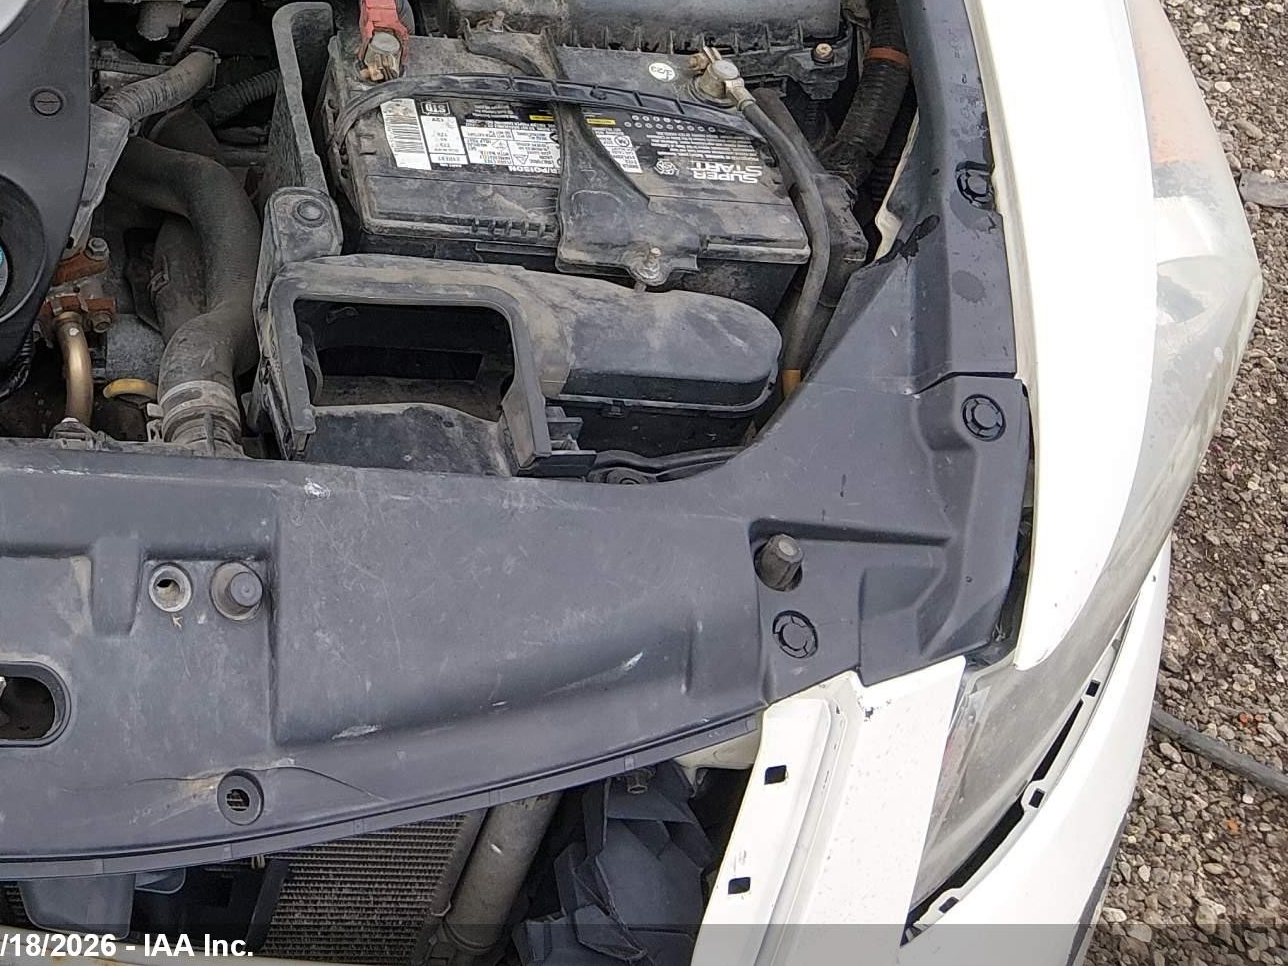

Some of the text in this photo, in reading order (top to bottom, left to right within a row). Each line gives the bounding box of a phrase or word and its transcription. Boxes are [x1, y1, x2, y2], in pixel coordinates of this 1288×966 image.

[424, 103, 447, 113] STD
[689, 161, 763, 177] START
[693, 170, 758, 184] SUPER
